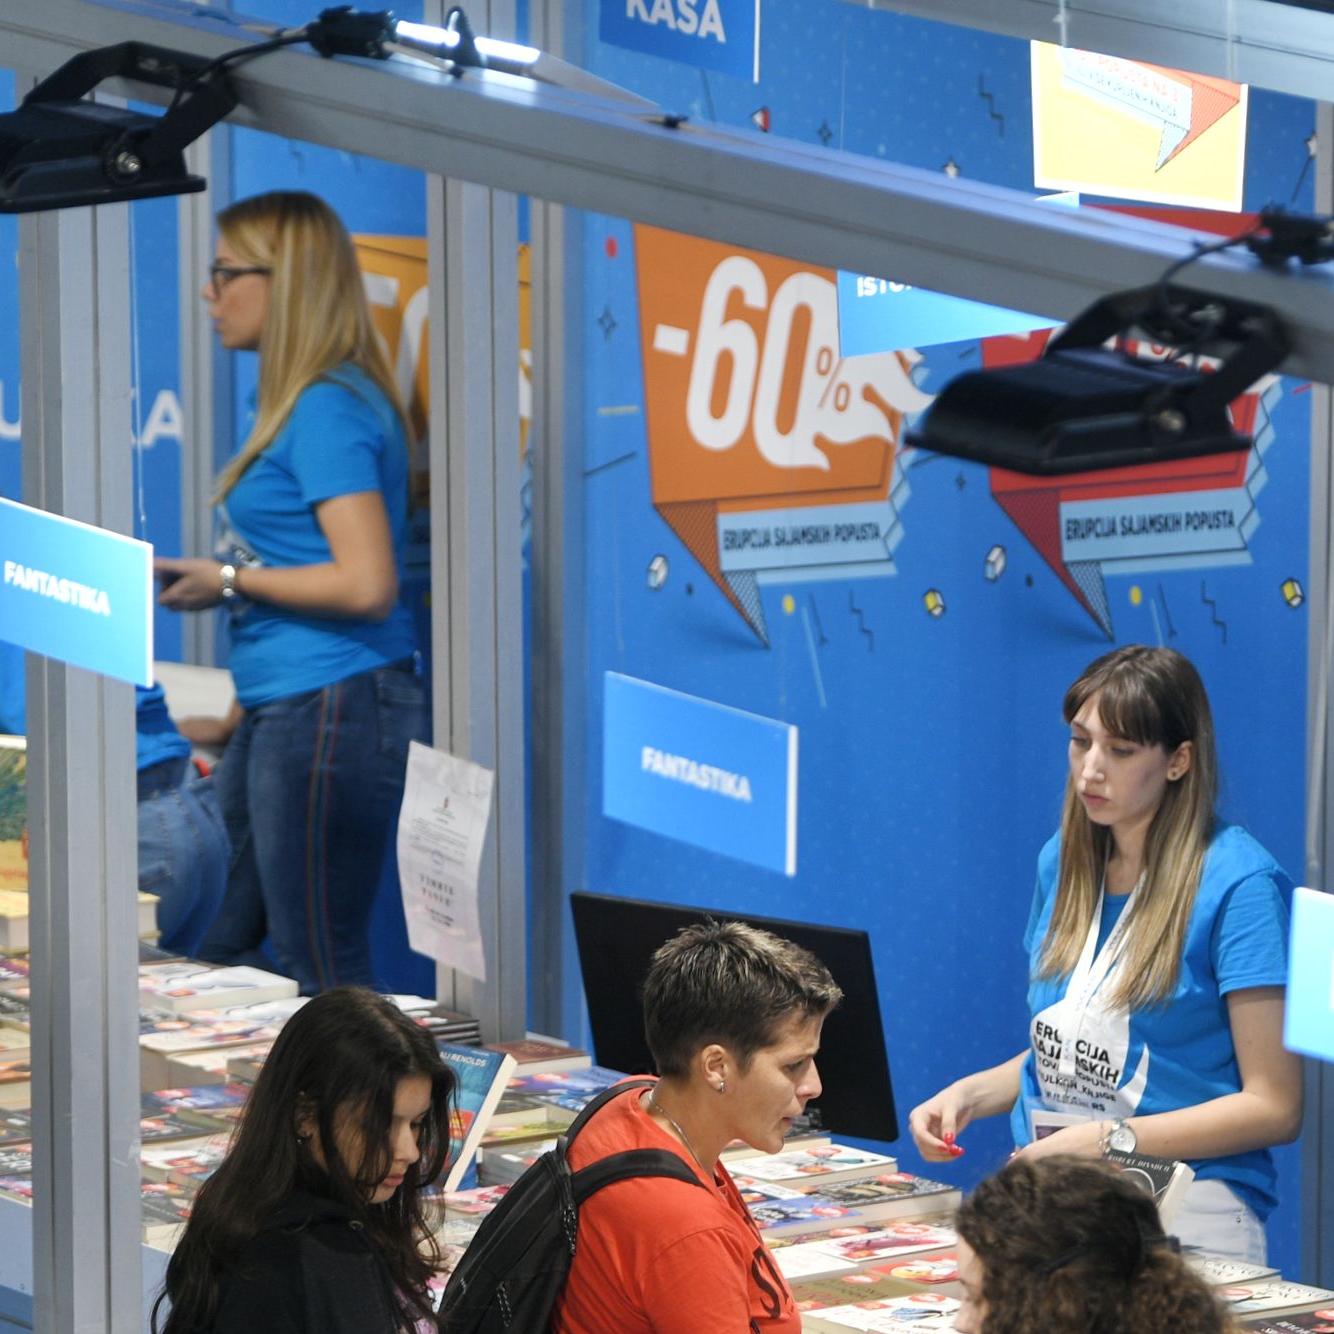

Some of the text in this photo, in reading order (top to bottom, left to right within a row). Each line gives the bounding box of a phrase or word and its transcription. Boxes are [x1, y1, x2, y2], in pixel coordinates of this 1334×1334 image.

[723, 521, 883, 551] ERUPCIJA SAJAMSKIH POPUSTA
[1066, 509, 1236, 541] ERUPCIJA SAJAMSKIH POPUSTA
[3, 560, 111, 617] FANTASTIKA
[641, 745, 753, 804] FANTASTIKA
